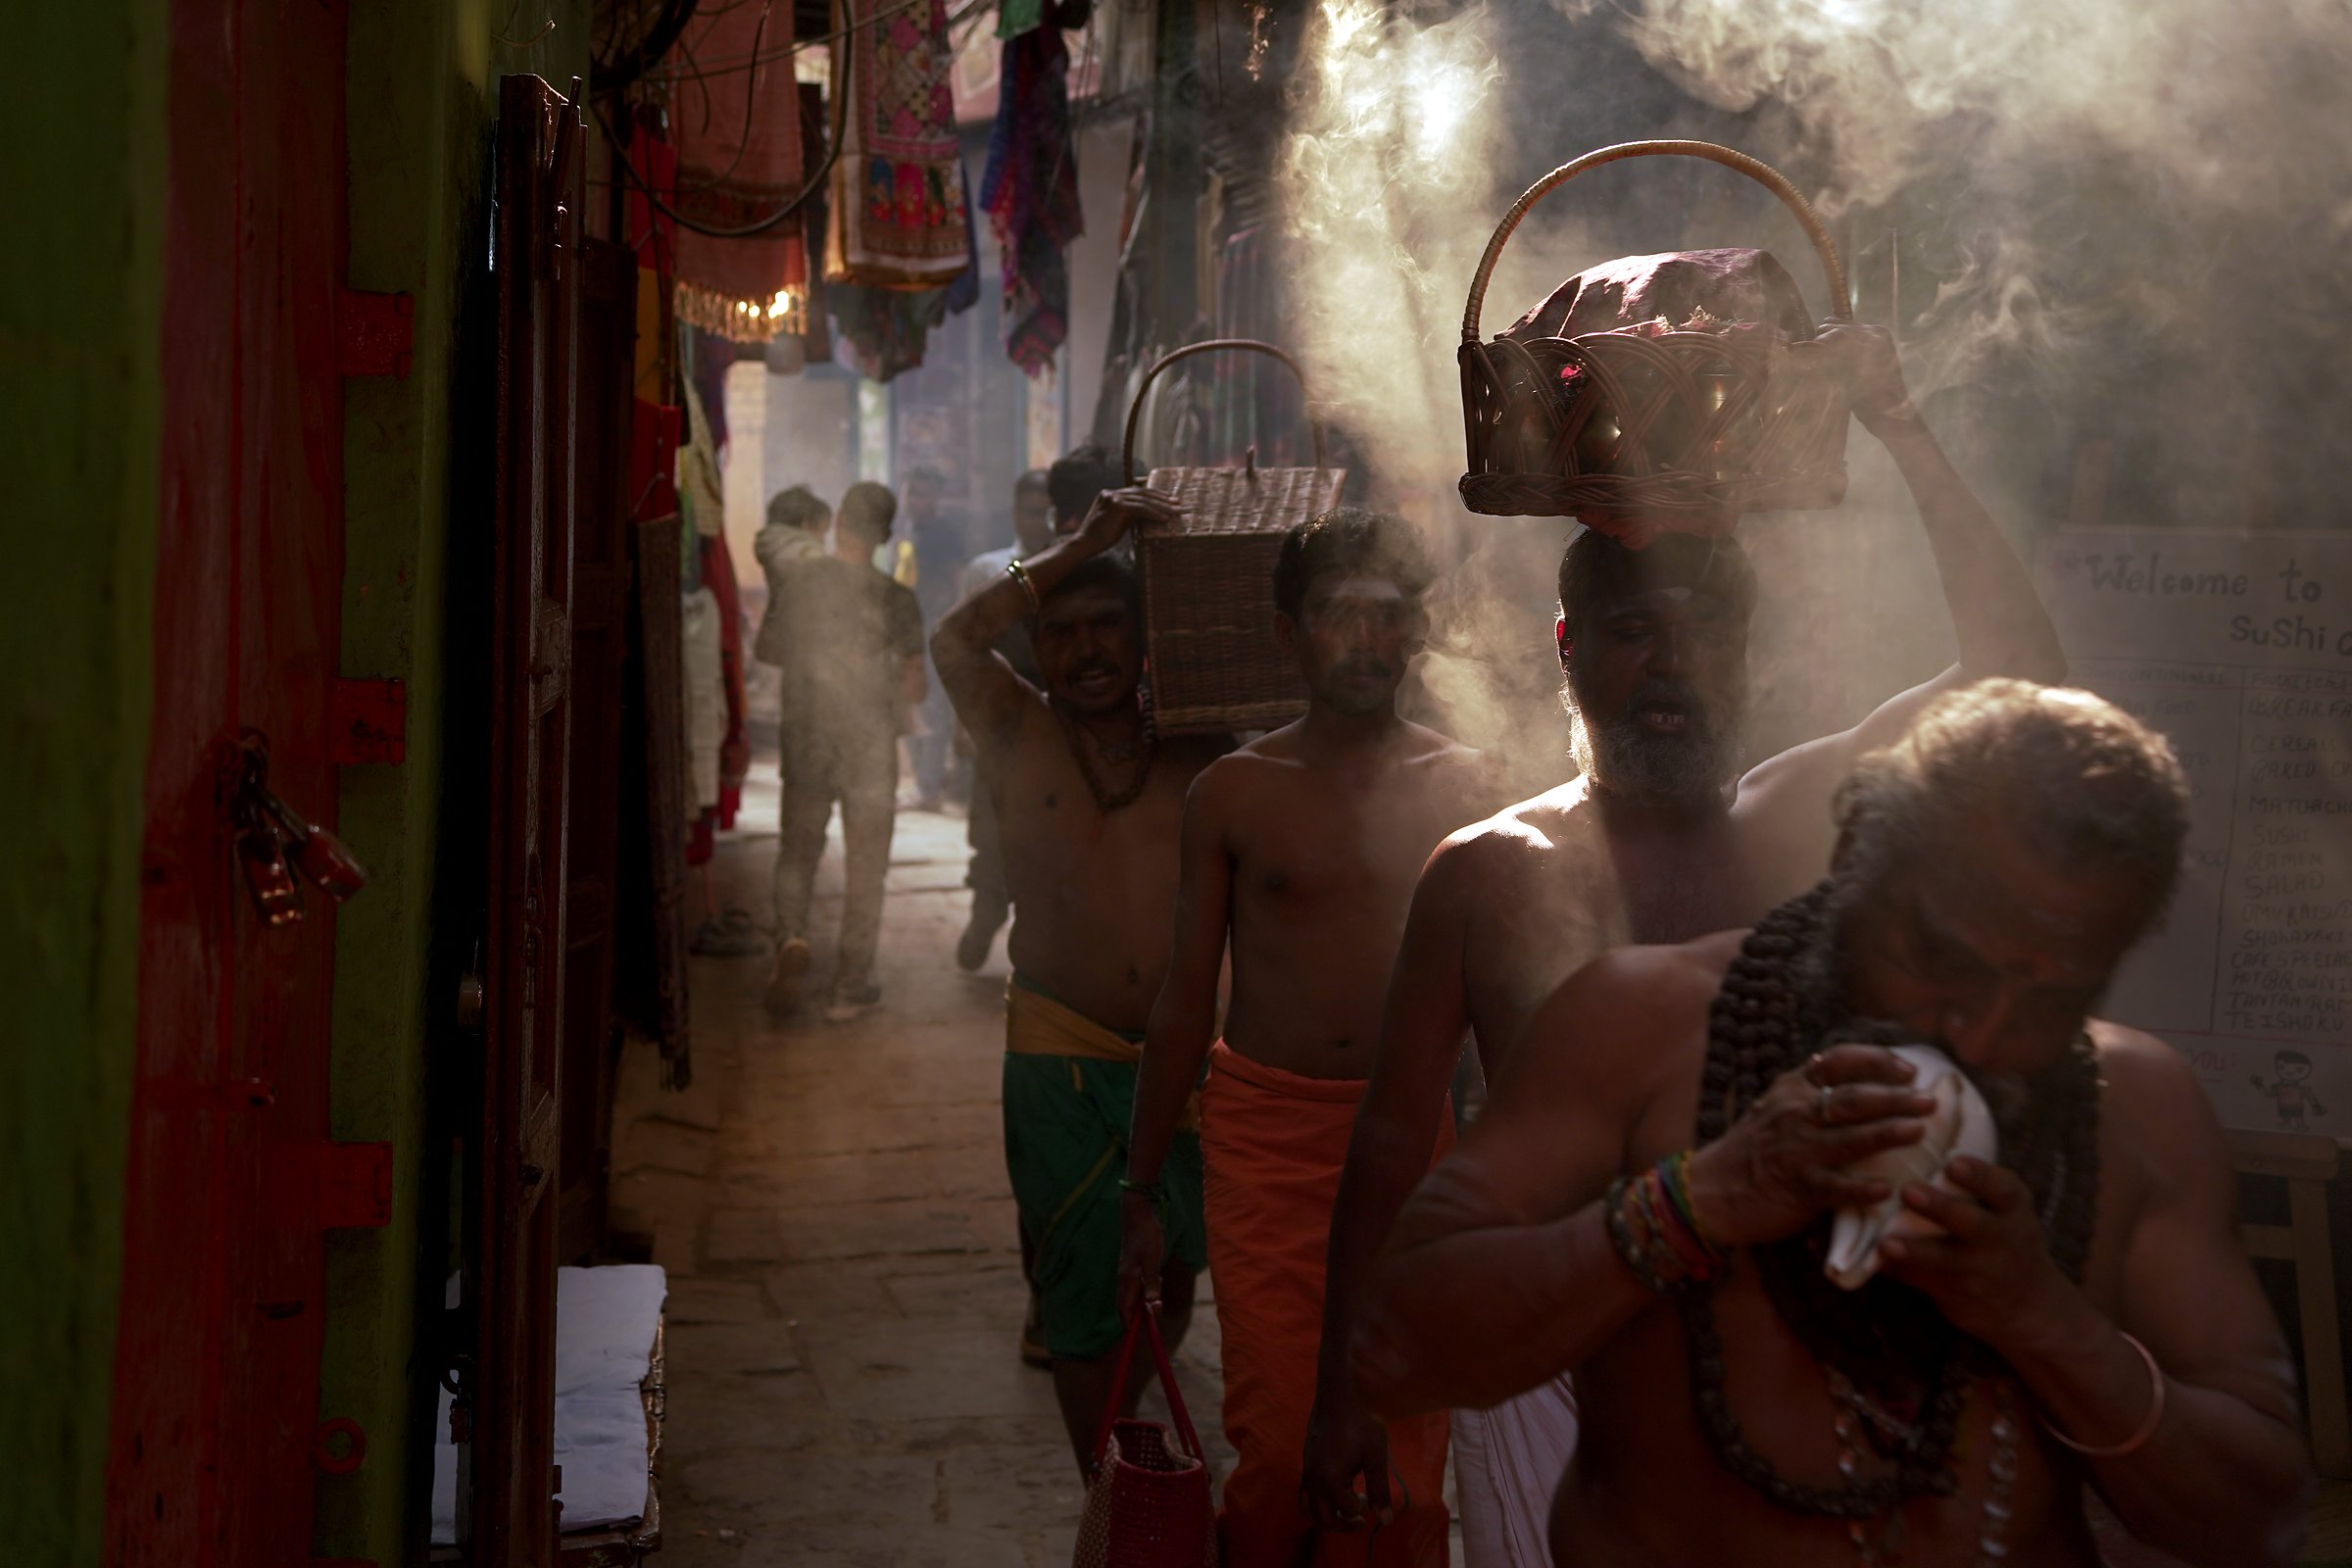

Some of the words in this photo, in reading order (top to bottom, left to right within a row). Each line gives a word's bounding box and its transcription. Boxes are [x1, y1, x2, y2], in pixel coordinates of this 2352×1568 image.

[2085, 552, 2249, 596] Welcome
[2278, 558, 2323, 603] to
[2248, 823, 2310, 847] SUSHI
[2241, 870, 2326, 899] SALAD
[2230, 951, 2273, 968] CAFE
[2231, 970, 2262, 986] HOT
[2261, 968, 2352, 992] BROWNI
[2224, 1010, 2345, 1032] TEISHOKU
